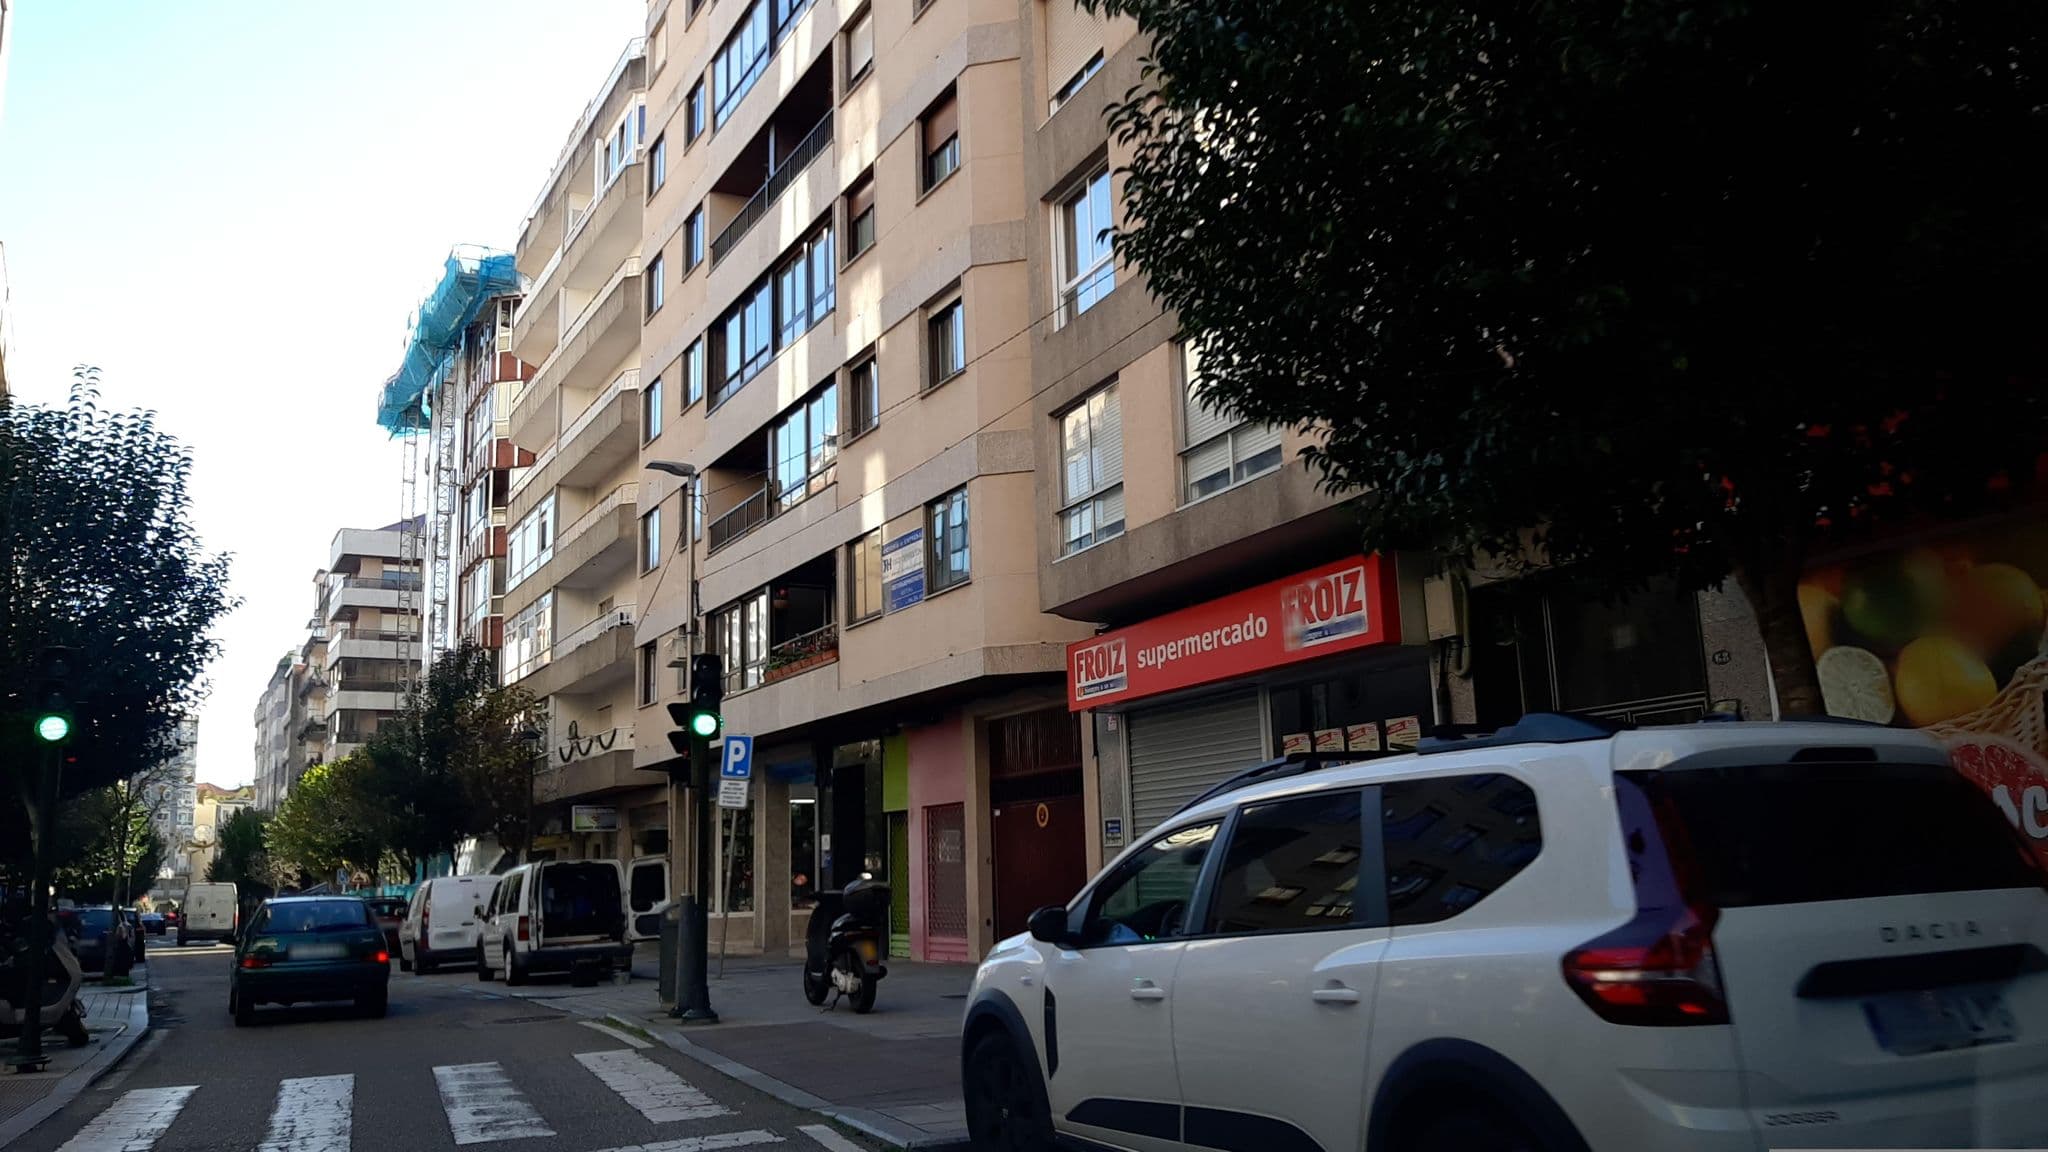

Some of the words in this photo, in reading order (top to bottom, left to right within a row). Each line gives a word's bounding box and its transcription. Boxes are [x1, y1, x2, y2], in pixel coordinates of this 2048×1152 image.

[1136, 612, 1269, 670] supermercado
[1076, 643, 1125, 684] FROIZ
[726, 739, 747, 773] P
[1879, 922, 1981, 943] DACIA
